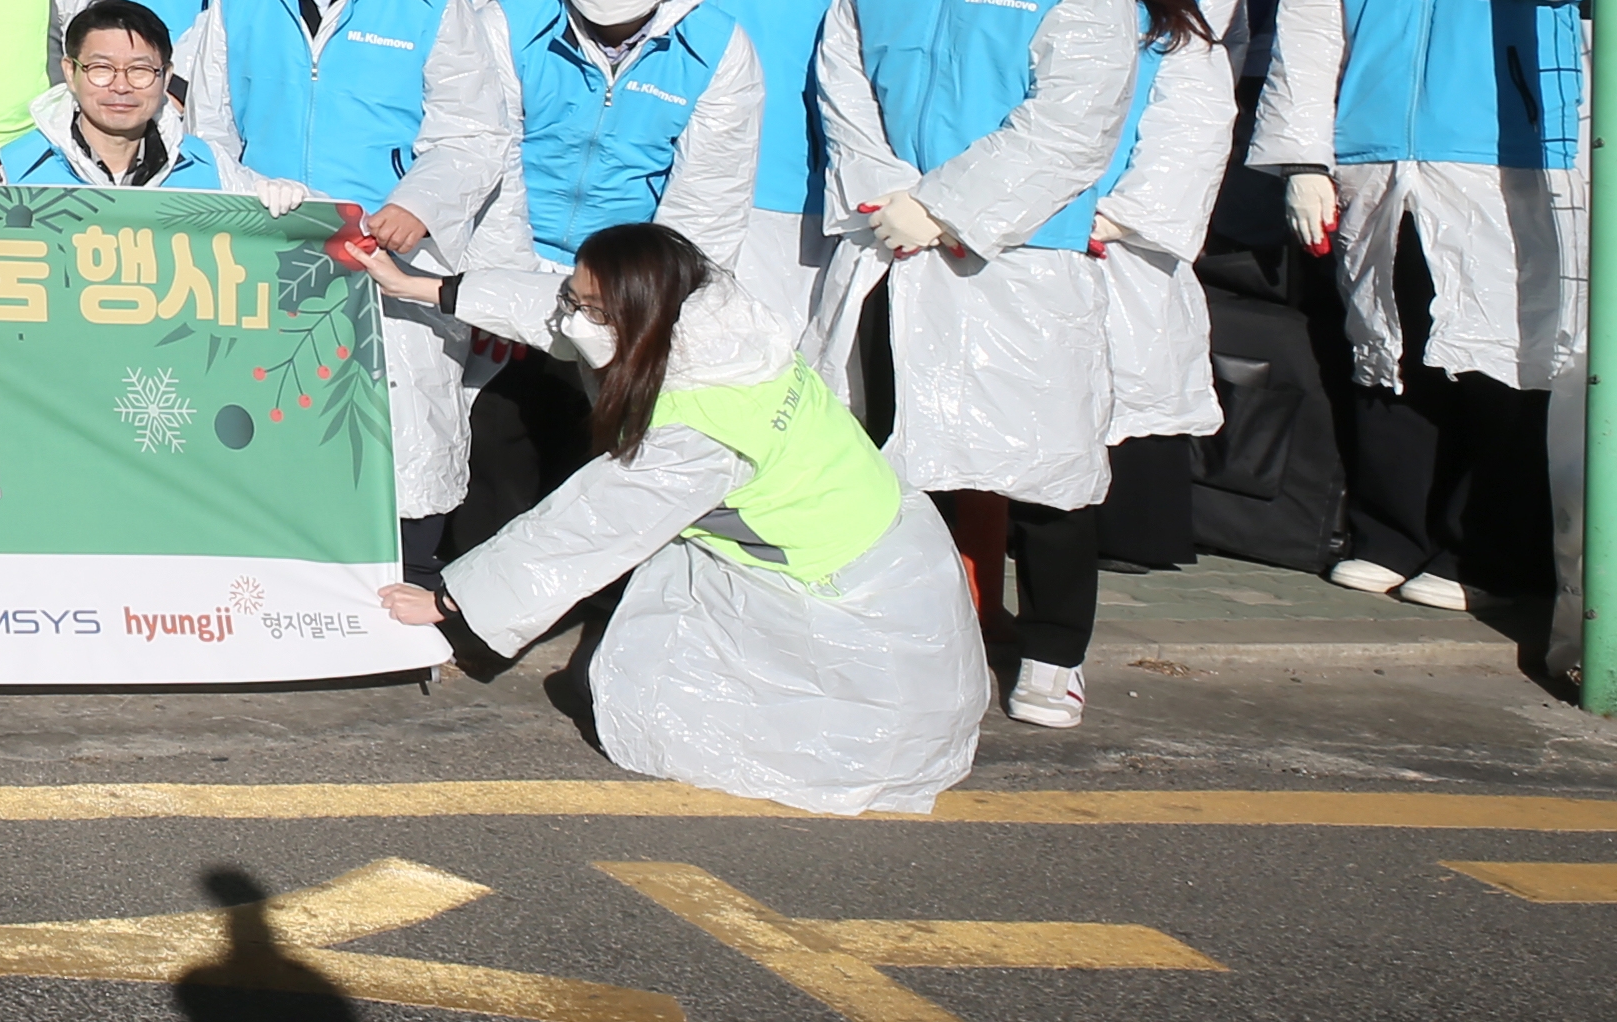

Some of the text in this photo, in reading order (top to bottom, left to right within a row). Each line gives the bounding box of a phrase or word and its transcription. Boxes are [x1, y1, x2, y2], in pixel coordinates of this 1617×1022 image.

[365, 33, 414, 50] Klemove
[641, 84, 687, 105] Klemove
[73, 226, 269, 328] 행사」
[125, 607, 368, 641] hyungji 형지엘리트
